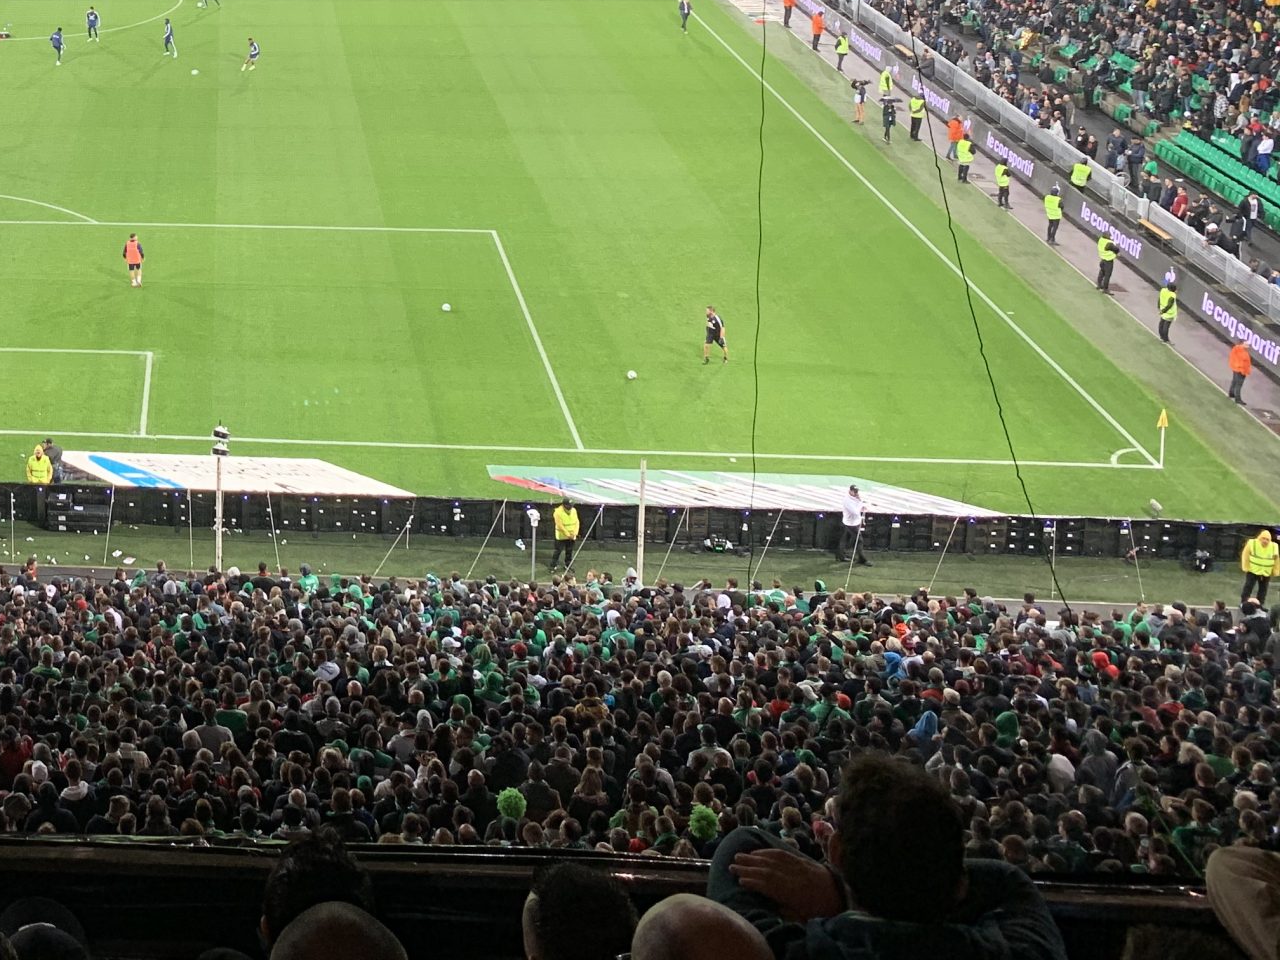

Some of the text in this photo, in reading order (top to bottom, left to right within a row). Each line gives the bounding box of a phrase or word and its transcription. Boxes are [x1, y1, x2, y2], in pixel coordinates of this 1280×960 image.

[994, 139, 1009, 159] coq
[1008, 150, 1035, 178] sportif
[1081, 201, 1142, 260] le coq sportif
[1202, 292, 1280, 365] le coq sportif
